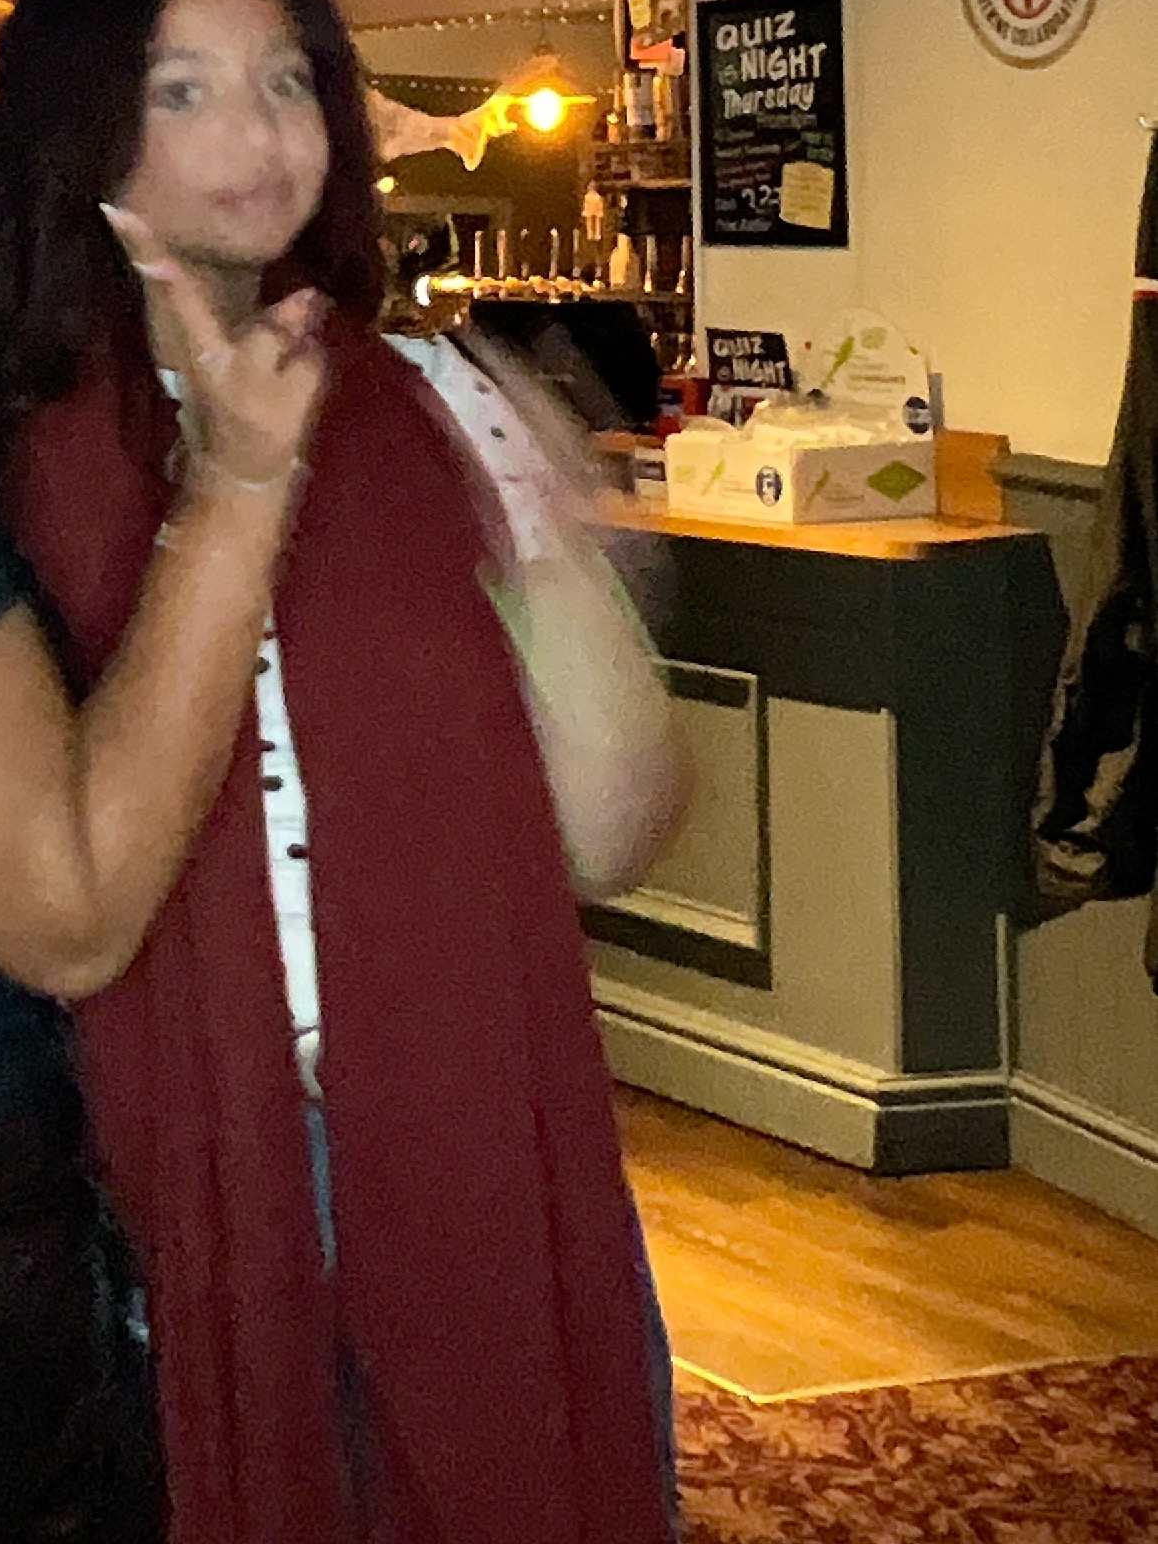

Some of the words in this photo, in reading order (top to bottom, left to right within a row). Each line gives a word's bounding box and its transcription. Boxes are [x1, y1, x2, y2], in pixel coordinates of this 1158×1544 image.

[715, 10, 796, 51] QUIZ
[740, 42, 827, 82] NIGHT
[722, 78, 815, 119] Thursday
